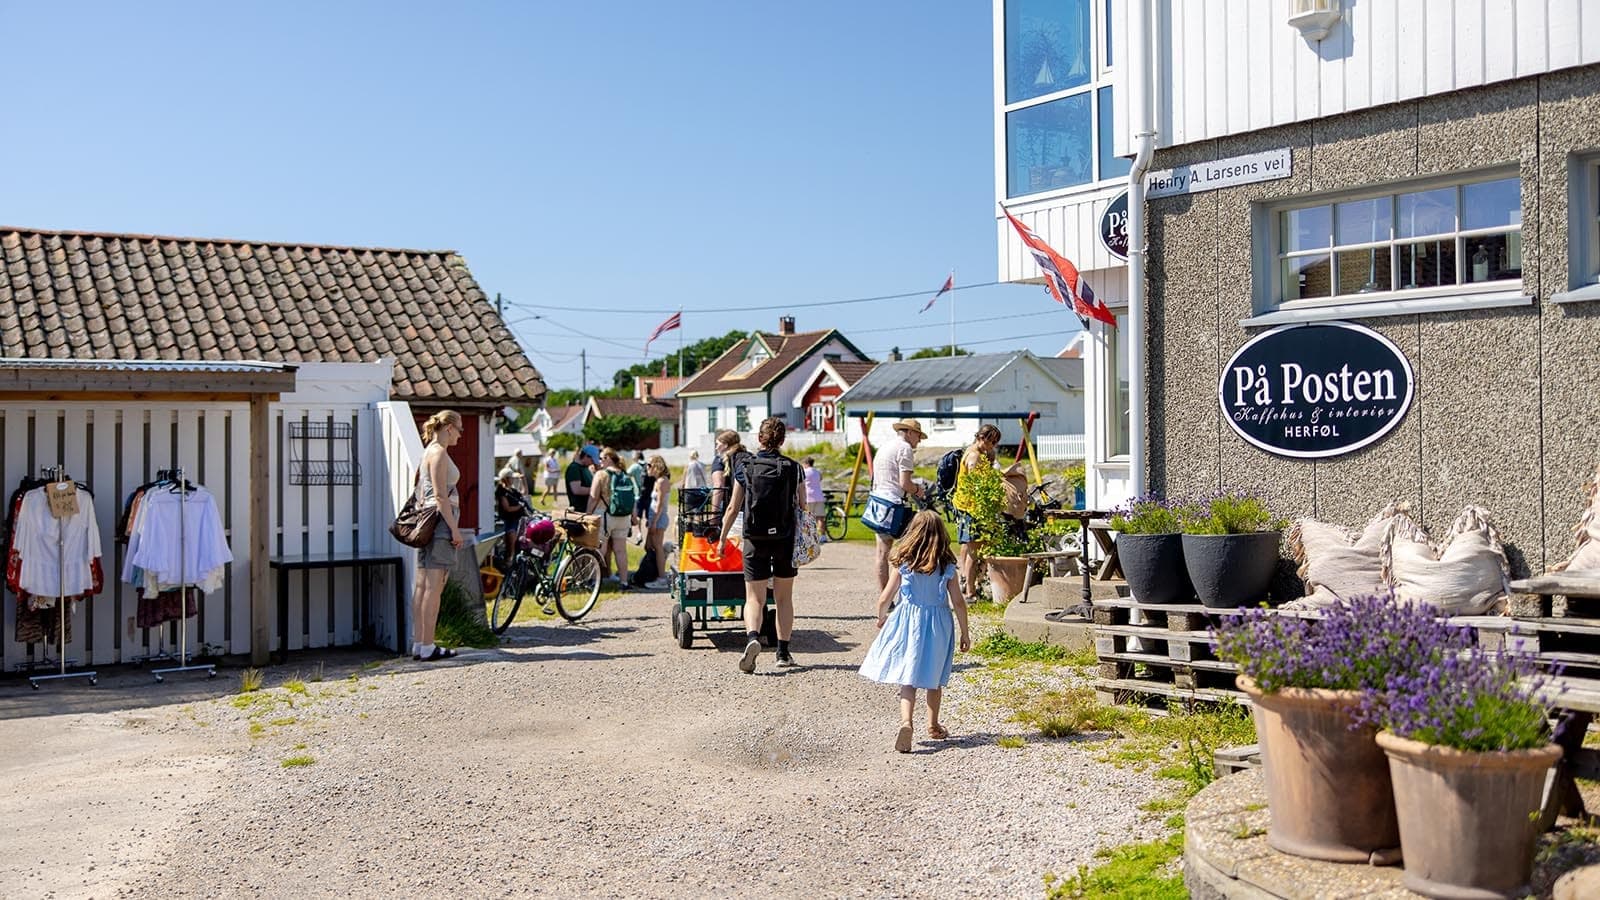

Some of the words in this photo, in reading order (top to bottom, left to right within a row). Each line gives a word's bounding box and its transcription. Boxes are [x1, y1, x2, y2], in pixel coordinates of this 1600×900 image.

[1149, 176, 1186, 191] Henry
[1190, 170, 1201, 184] A.
[1206, 162, 1258, 181] Larsens
[1264, 154, 1285, 171] vei
[1233, 364, 1273, 407] På
[1280, 363, 1397, 405] Posten
[1233, 406, 1304, 424] Kaffehus
[1310, 406, 1324, 424] &
[1328, 405, 1395, 419] interiør
[1285, 425, 1340, 438] HERFØL
